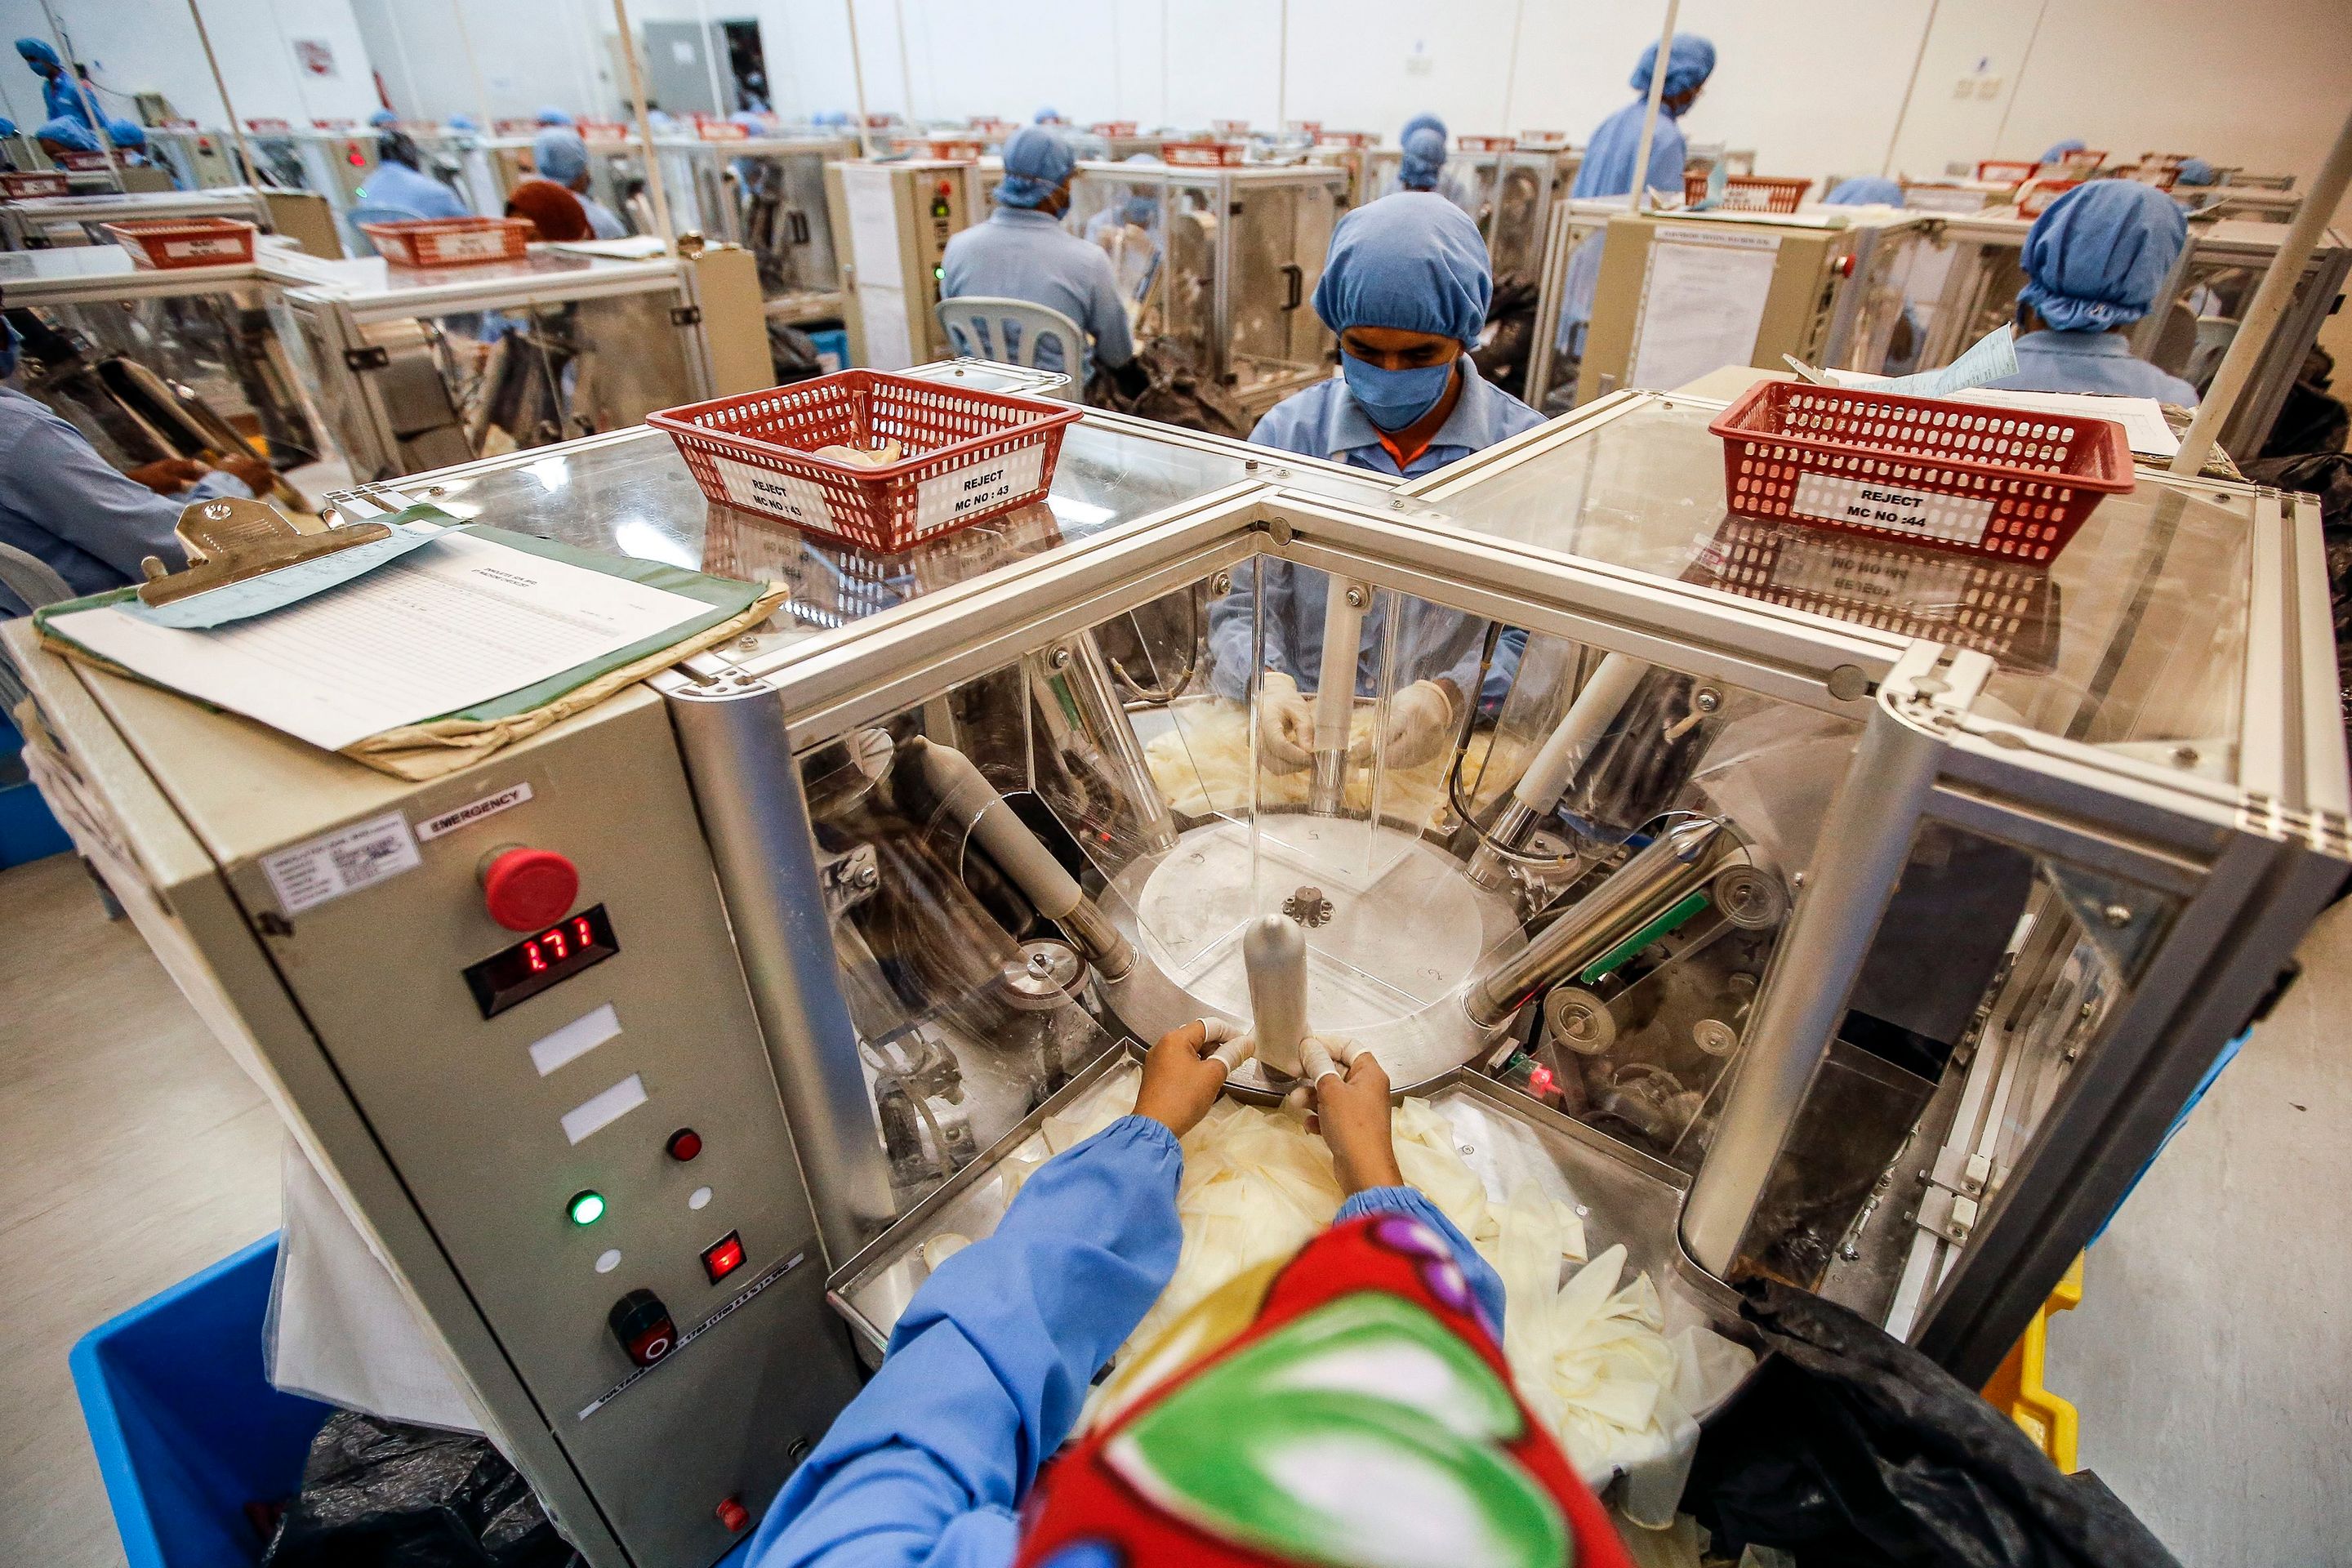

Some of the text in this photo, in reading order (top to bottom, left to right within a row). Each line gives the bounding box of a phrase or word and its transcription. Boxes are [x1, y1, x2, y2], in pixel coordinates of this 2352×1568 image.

[752, 479, 786, 497] REJECT
[964, 470, 1004, 491] REJECT
[753, 495, 768, 506] MC
[768, 499, 783, 510] NO
[791, 506, 802, 517] 43
[955, 499, 971, 511] MC
[973, 492, 988, 505] NO
[997, 484, 1009, 497] 43
[1861, 490, 1923, 507] REJECT
[1846, 506, 1870, 517] MC
[1874, 510, 1898, 522] NO
[430, 789, 519, 833] EMERGENCY
